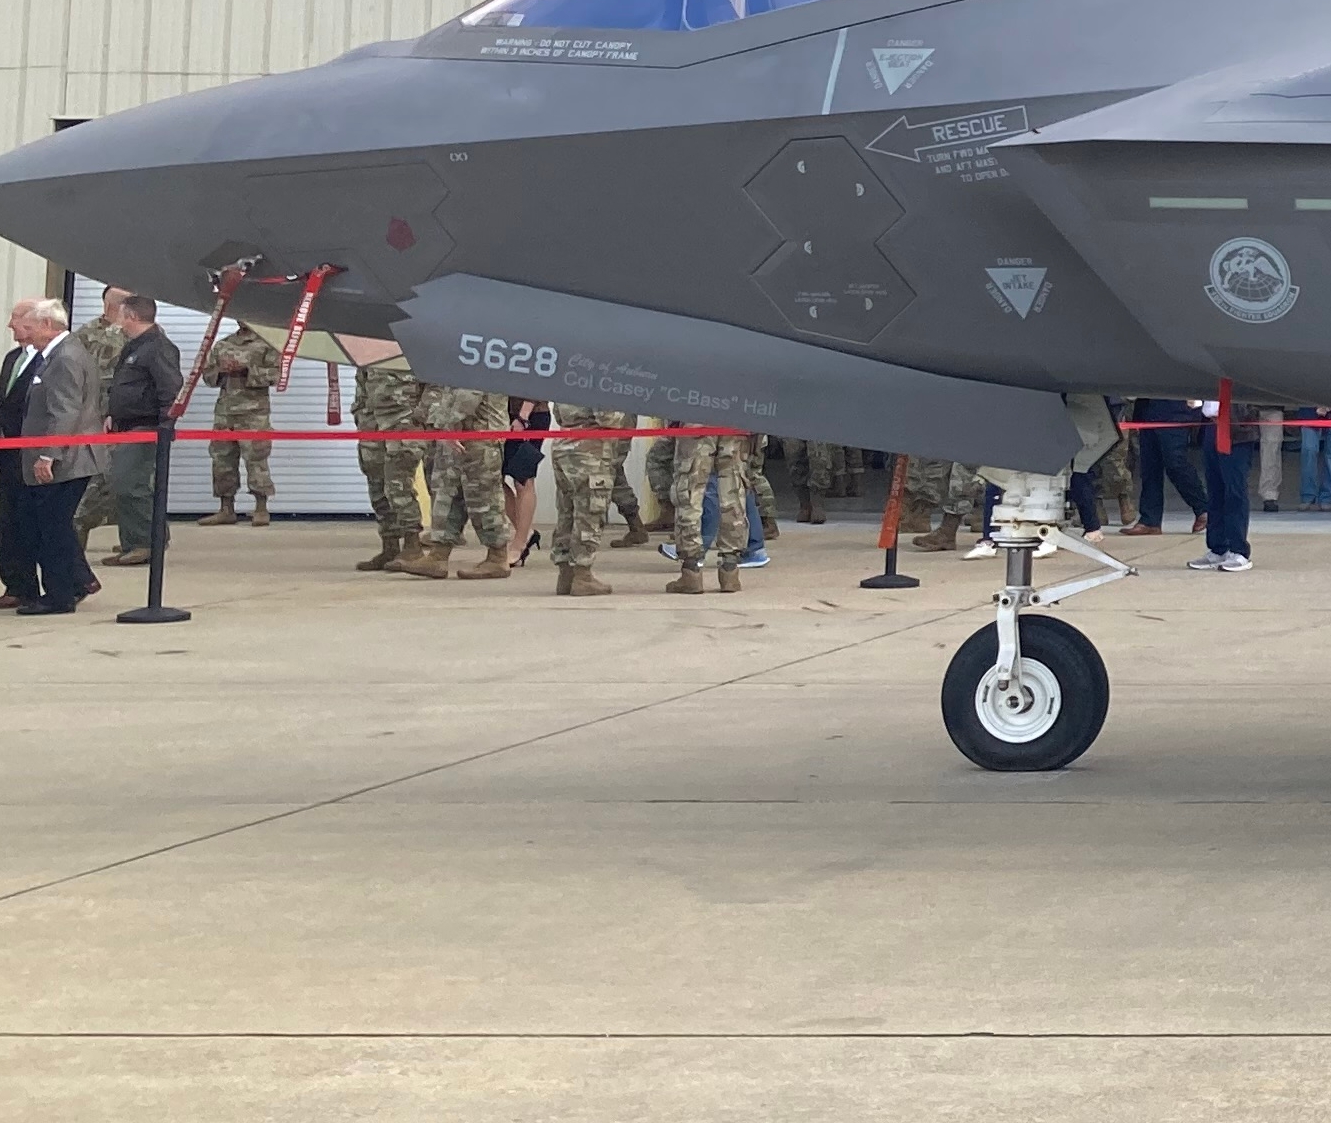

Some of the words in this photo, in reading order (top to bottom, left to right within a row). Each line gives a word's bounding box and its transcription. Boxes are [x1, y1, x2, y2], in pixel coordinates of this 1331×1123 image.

[519, 48, 551, 57] INCHES
[553, 48, 566, 57] OF
[567, 49, 605, 59] CANOPY
[605, 51, 639, 61] FRAME
[540, 39, 552, 48] DO
[553, 39, 571, 48] NOT
[573, 40, 593, 49] CUT
[595, 41, 632, 51] CANOPY
[931, 114, 1008, 142] RESCUE
[458, 333, 558, 377] 5628
[563, 371, 594, 390] Col
[599, 377, 655, 403] Casey
[660, 386, 739, 410] "C-Bass"
[743, 398, 778, 417] Hall
